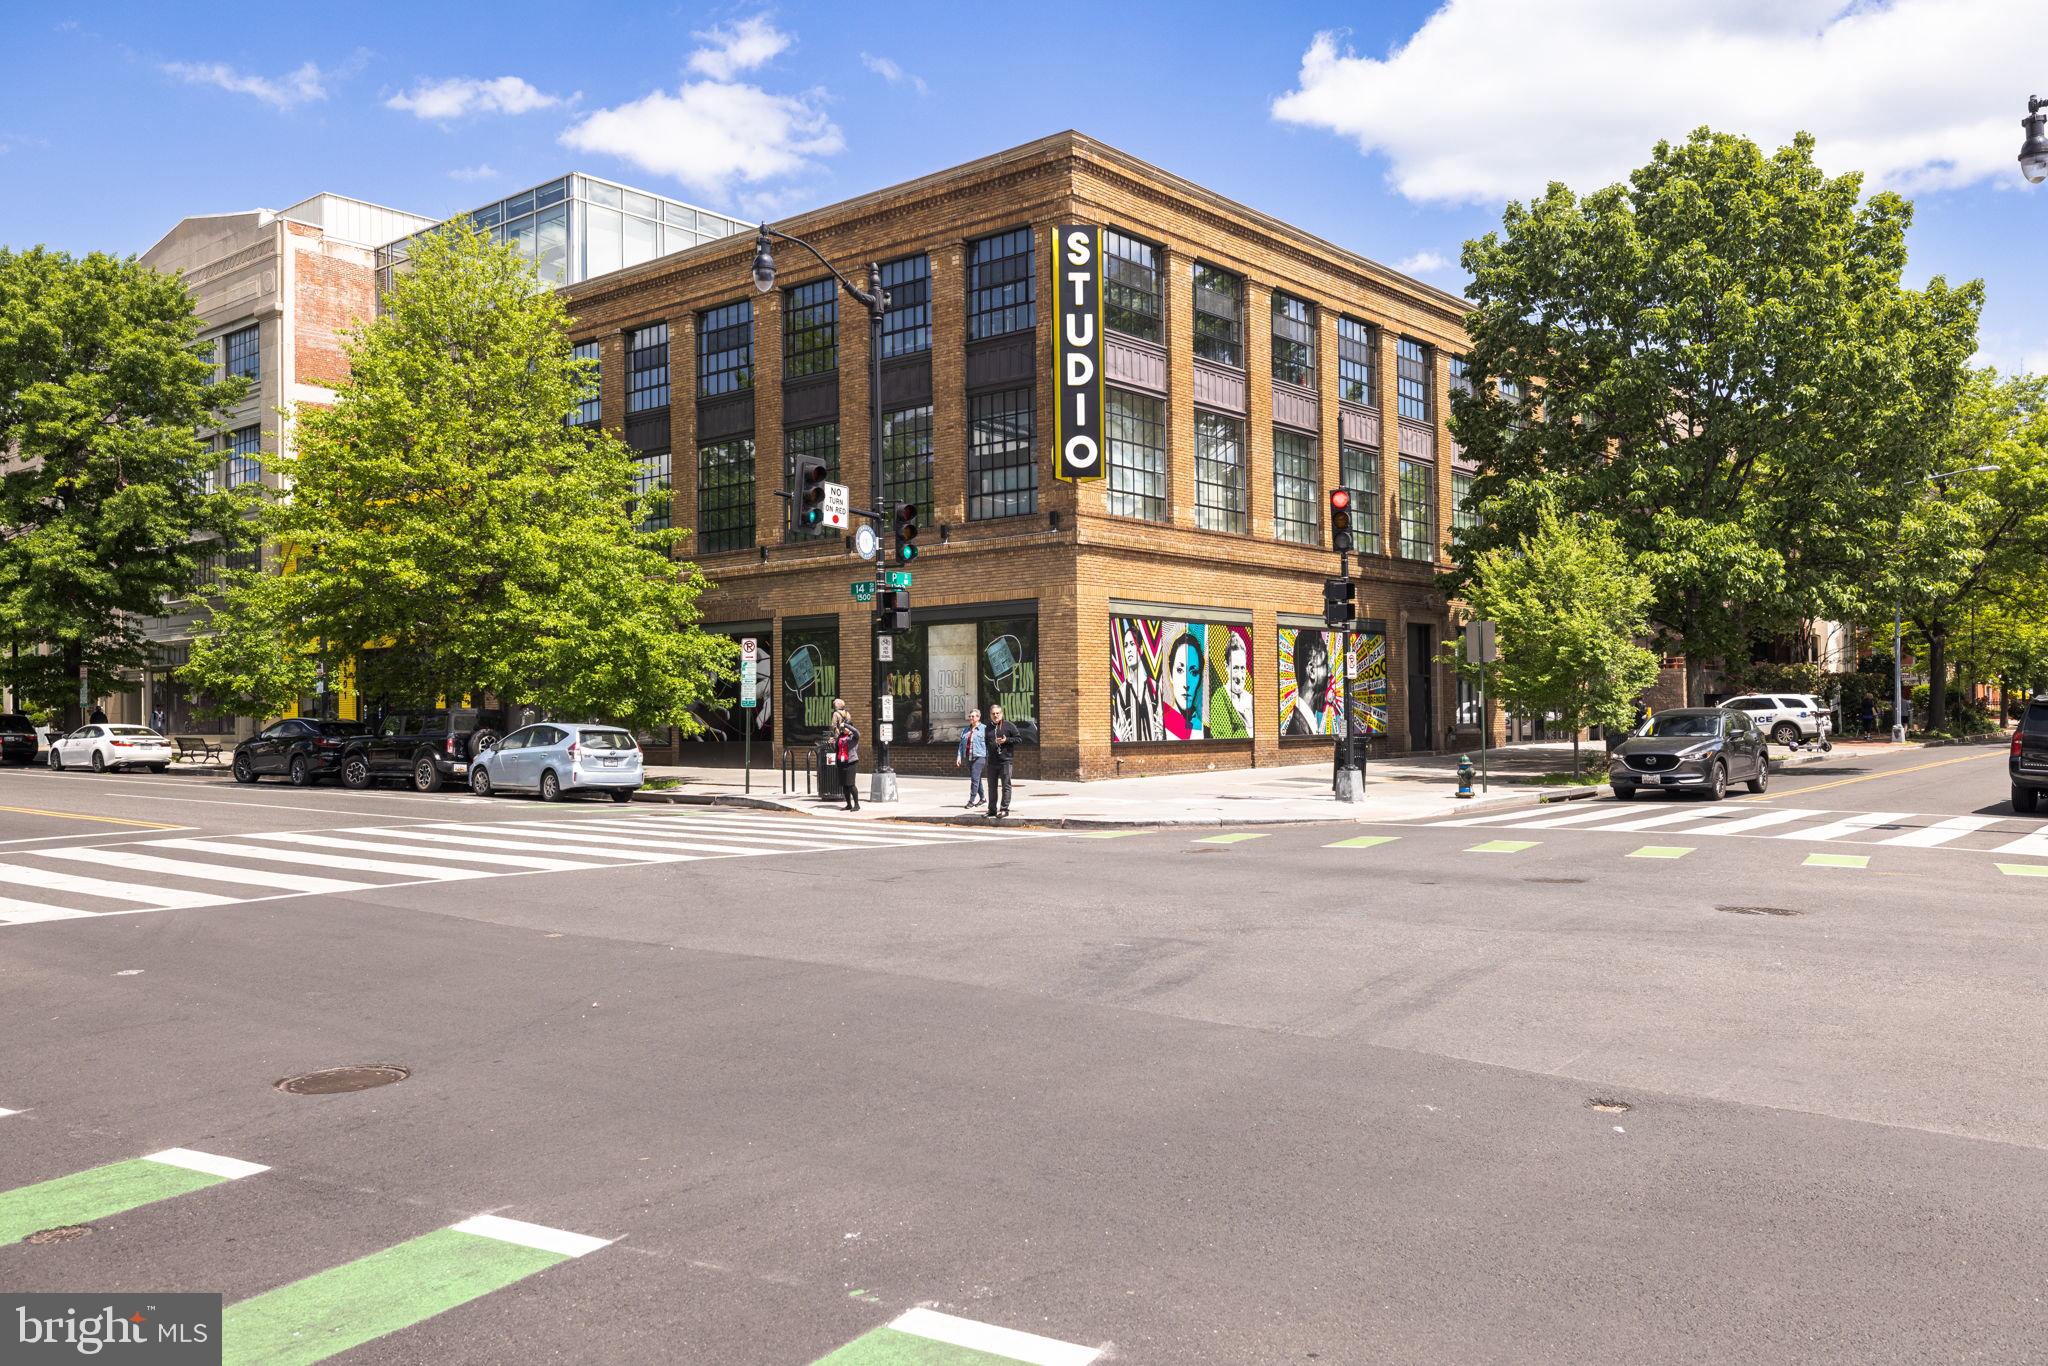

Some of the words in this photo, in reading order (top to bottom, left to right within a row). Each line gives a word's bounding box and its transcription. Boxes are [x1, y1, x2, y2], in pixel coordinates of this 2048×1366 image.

[1065, 231, 1098, 469] STUDIO
[829, 496, 844, 506] TURN
[830, 487, 842, 497] NO
[835, 506, 847, 515] RED
[855, 583, 866, 594] 14
[892, 572, 898, 582] P
[814, 665, 836, 696] FUN
[938, 662, 967, 694] good
[1011, 662, 1034, 692] FUN
[804, 696, 835, 727] HOME
[930, 688, 967, 714] bones
[1000, 692, 1034, 722] HOME
